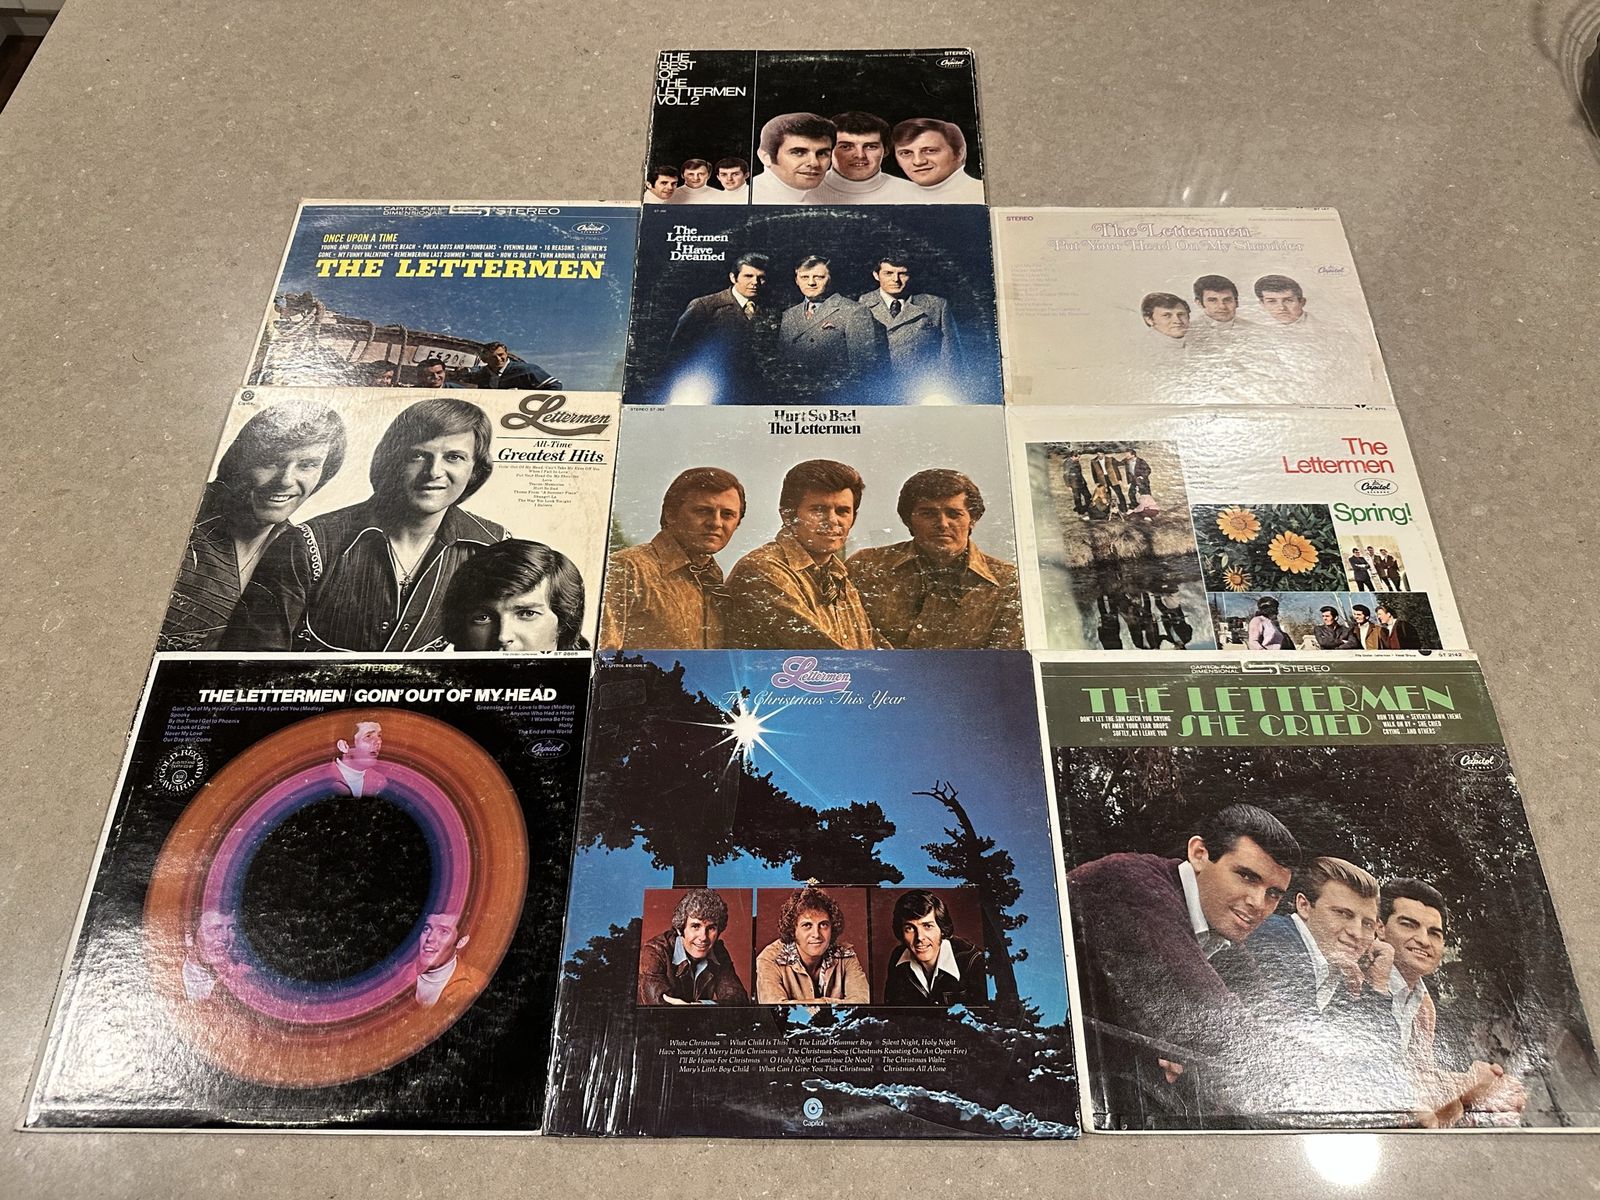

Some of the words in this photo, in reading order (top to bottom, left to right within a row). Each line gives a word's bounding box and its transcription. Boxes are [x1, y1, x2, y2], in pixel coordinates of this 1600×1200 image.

[661, 52, 690, 62] THE
[659, 61, 696, 70] BEST
[658, 70, 680, 78] OF
[658, 78, 688, 88] THE
[656, 86, 746, 96] LETTERMEN
[656, 96, 688, 106] VOL.
[690, 96, 700, 106] 2
[493, 207, 560, 215] STEREO
[673, 226, 698, 234] The
[1092, 222, 1138, 238] The
[1138, 222, 1252, 238] Lettermen
[323, 234, 345, 242] ONCE
[346, 234, 370, 242] UPON
[370, 234, 376, 242] A
[378, 233, 398, 242] TIME
[666, 232, 728, 242] Lettermen
[676, 242, 682, 250] I
[682, 244, 713, 254] Have
[670, 251, 726, 260] Dreamed
[316, 259, 384, 278] THE
[396, 259, 605, 279] LETTERMEN
[500, 394, 611, 436] Lettermen
[774, 410, 806, 422] Hurt
[808, 409, 827, 422] So
[829, 410, 856, 422] Bad
[768, 422, 792, 434] The
[794, 422, 861, 434] Lettermen
[533, 440, 573, 448] All-Time
[1342, 438, 1388, 455] The
[498, 448, 566, 462] Greatest
[568, 449, 604, 462] Hits
[1282, 456, 1395, 474] Lettermen
[1361, 482, 1391, 490] Capitol
[1334, 503, 1413, 526] Spring!
[1282, 664, 1331, 672] STEREO
[770, 656, 852, 694] Lettermen
[199, 689, 234, 702] THE
[236, 689, 346, 702] LETTERMEN
[354, 688, 404, 702] GOIN'
[405, 688, 445, 702] OUT
[446, 688, 472, 702] OF
[474, 688, 503, 702] MY
[504, 688, 557, 702] HEAD
[753, 690, 824, 706] Christmas
[830, 690, 864, 706] This
[868, 690, 908, 710] Year
[1081, 687, 1174, 713] THE
[1186, 685, 1455, 713] LETTERMEN
[1177, 714, 1249, 737] SHE
[1259, 714, 1372, 736] CRIED
[532, 742, 565, 752] Capitol
[1460, 754, 1494, 766] Capitol
[901, 1038, 920, 1046] Night,
[812, 1056, 843, 1064] (Cantique
